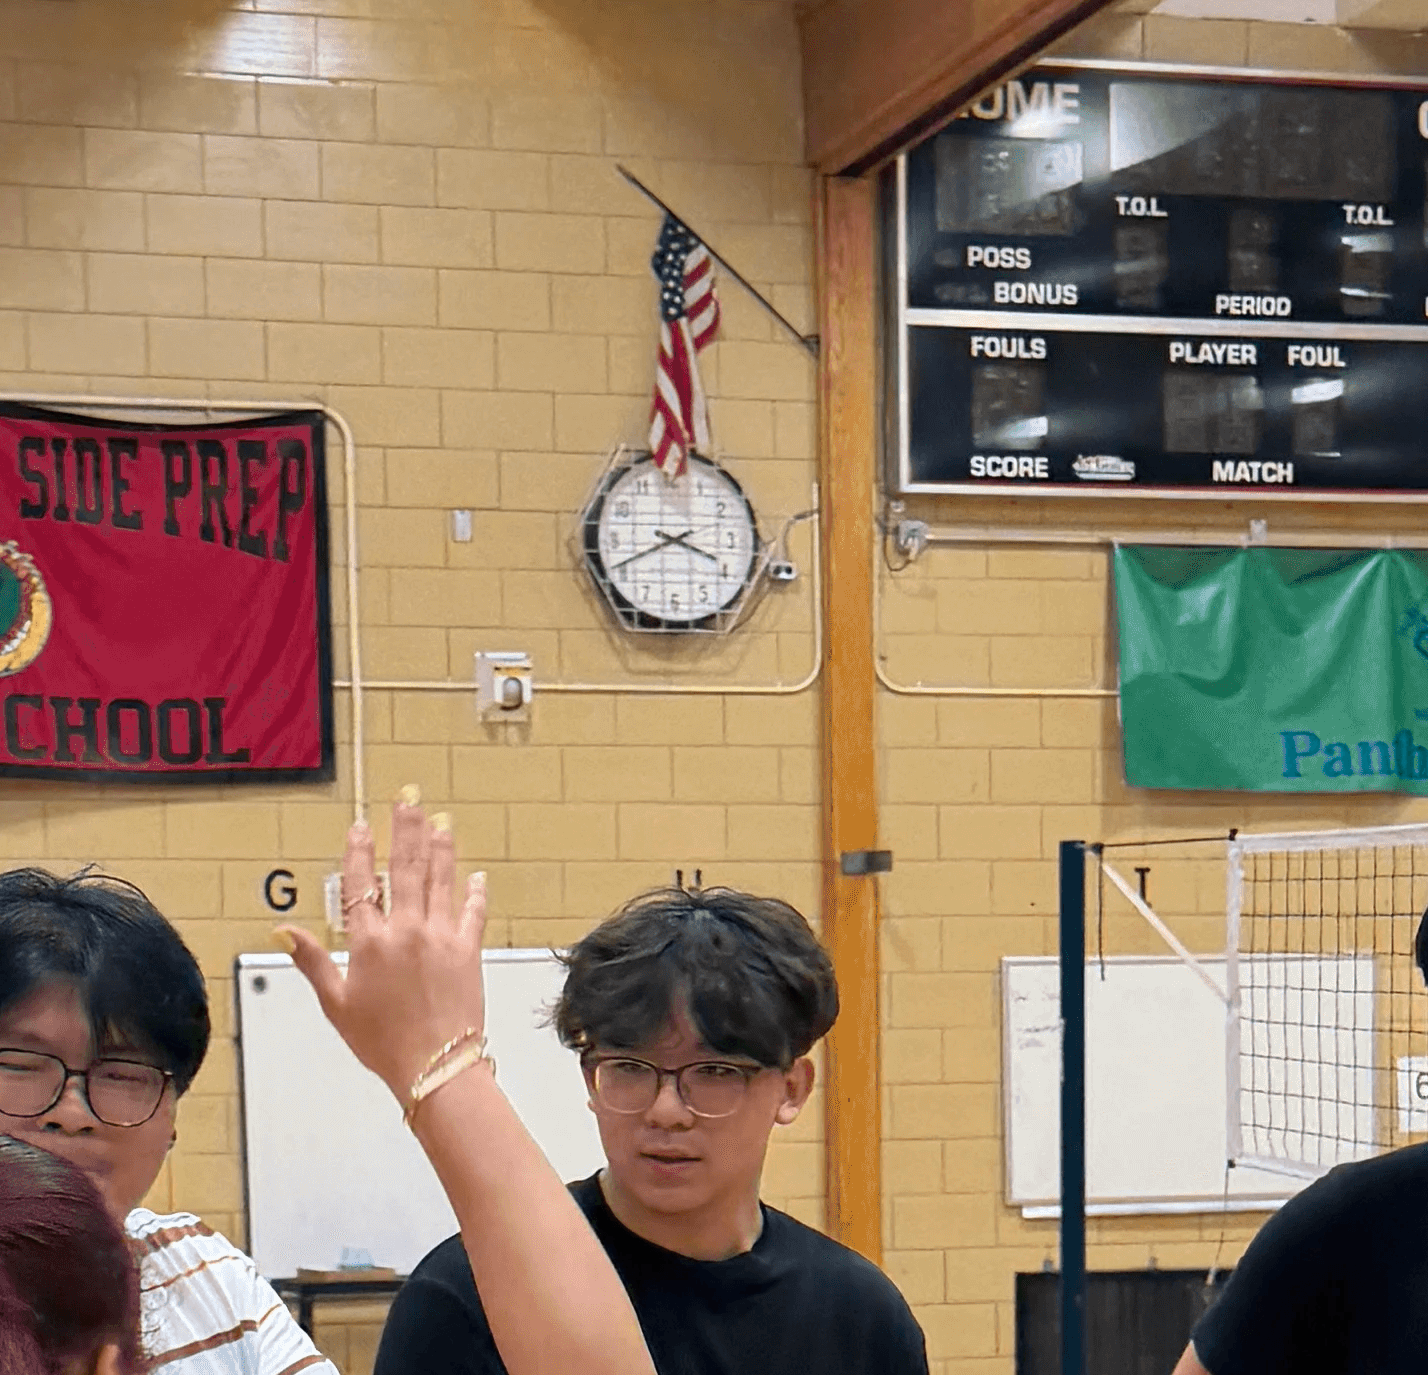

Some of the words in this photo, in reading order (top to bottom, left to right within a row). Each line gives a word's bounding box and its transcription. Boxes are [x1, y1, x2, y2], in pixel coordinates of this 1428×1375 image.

[958, 81, 1080, 123] OME
[967, 245, 1032, 270] POSS
[994, 281, 1078, 306] BONUS
[1215, 294, 1292, 316] PERIOD
[971, 336, 1048, 360] FOULS
[1169, 342, 1258, 365] PLAYER
[1287, 345, 1346, 368] FOUL
[970, 456, 1049, 478] SCORE
[1212, 461, 1294, 484] MATCH
[18, 436, 142, 530] SIDE
[162, 438, 309, 563] PREP
[264, 869, 298, 912] G
